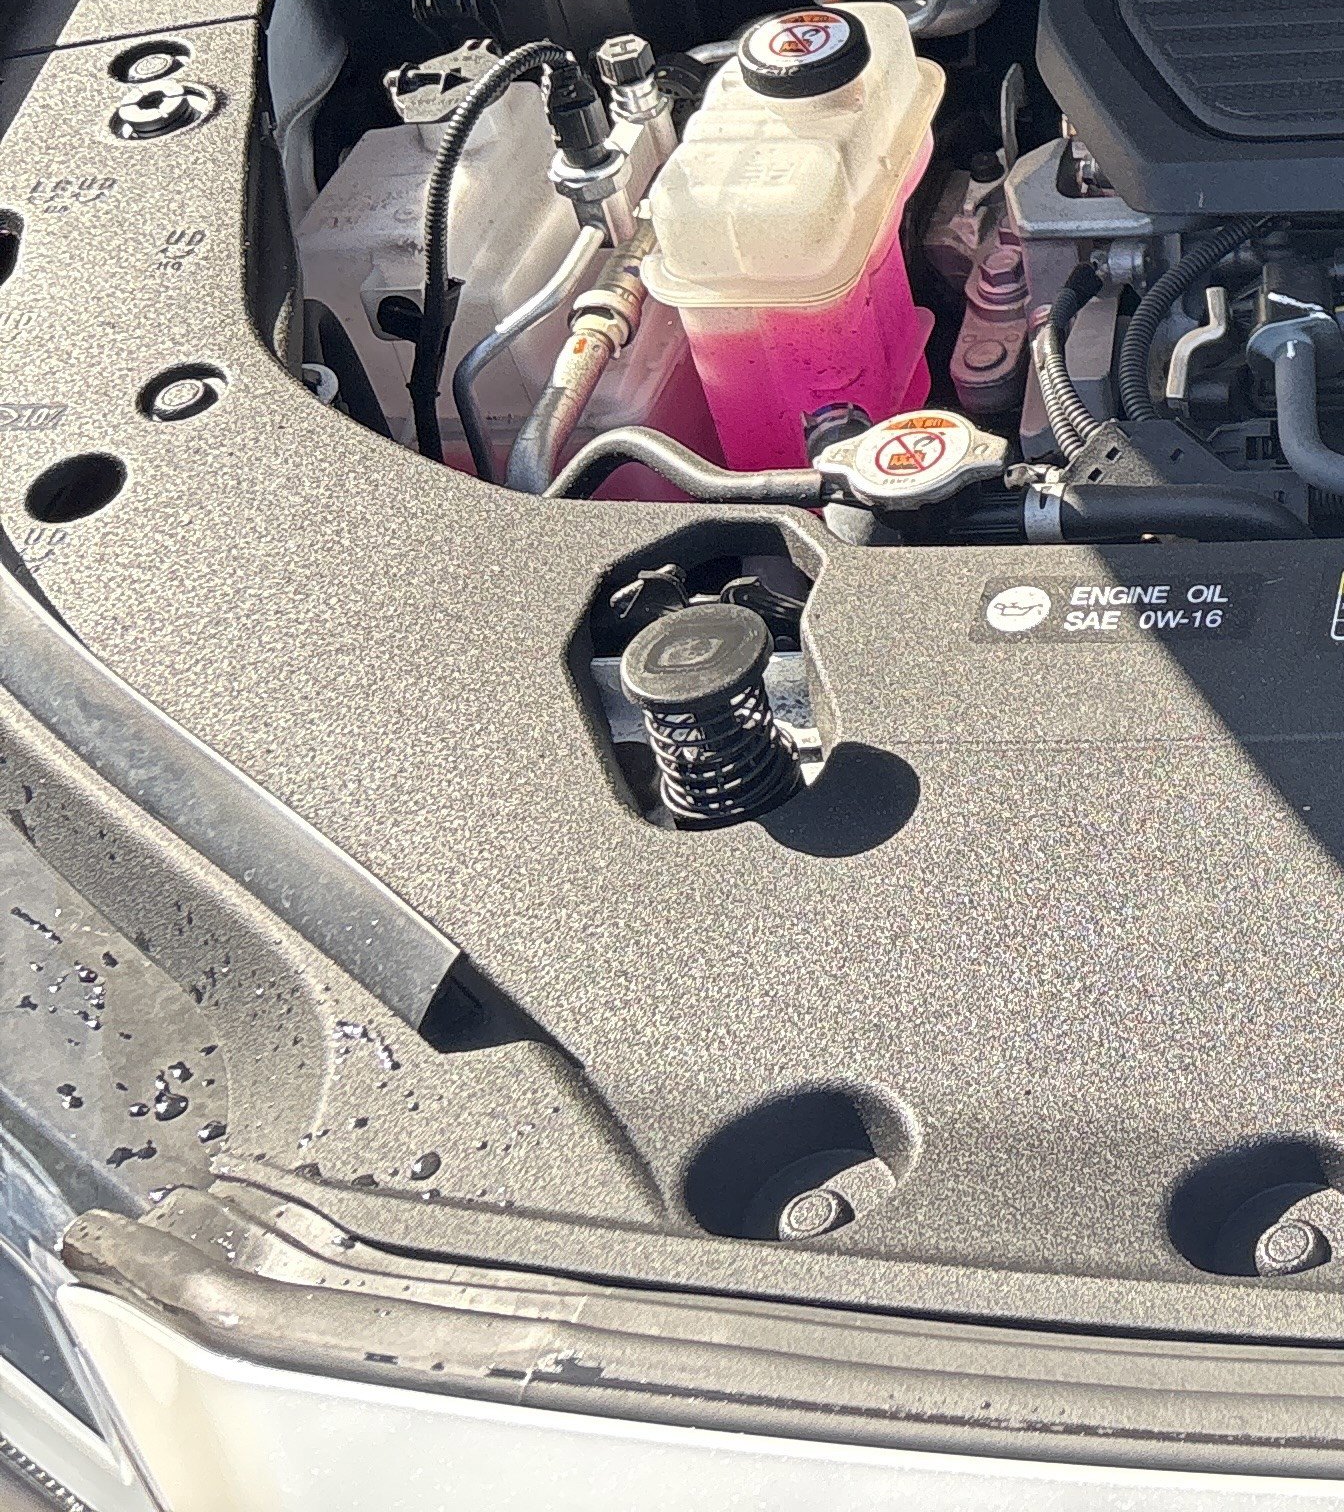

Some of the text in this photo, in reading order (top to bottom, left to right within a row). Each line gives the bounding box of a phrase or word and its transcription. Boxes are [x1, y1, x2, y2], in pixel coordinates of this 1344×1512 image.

[1070, 584, 1229, 606] ENGINE OIL
[1063, 609, 1224, 631] SAE 0W-16
